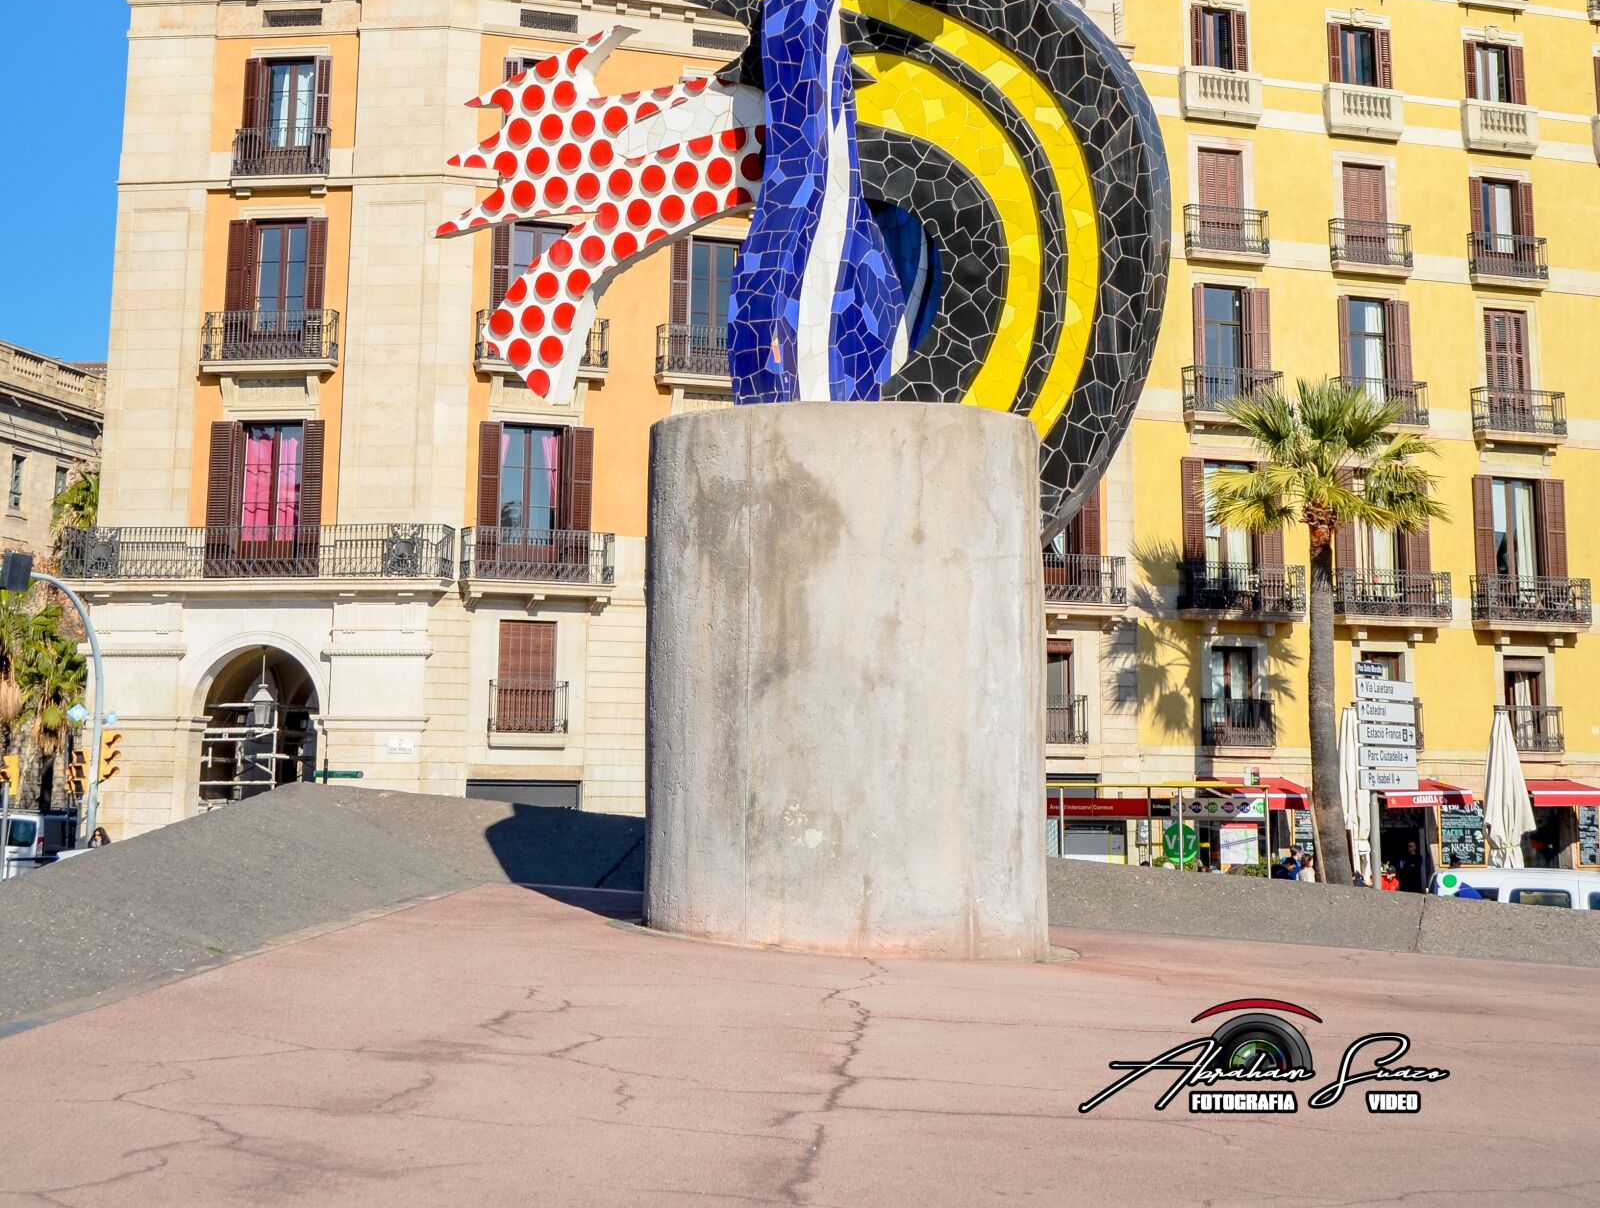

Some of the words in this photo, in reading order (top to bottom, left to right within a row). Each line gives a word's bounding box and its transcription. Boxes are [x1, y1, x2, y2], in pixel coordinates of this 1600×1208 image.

[1365, 682, 1373, 693] Via
[1374, 682, 1394, 695] Laietana
[1366, 703, 1387, 716] Catedral
[1367, 727, 1385, 739] Estació
[1386, 728, 1402, 741] França
[1368, 750, 1379, 761] Parc
[1380, 750, 1404, 762] Ciutadella
[1377, 773, 1391, 784] Isabel
